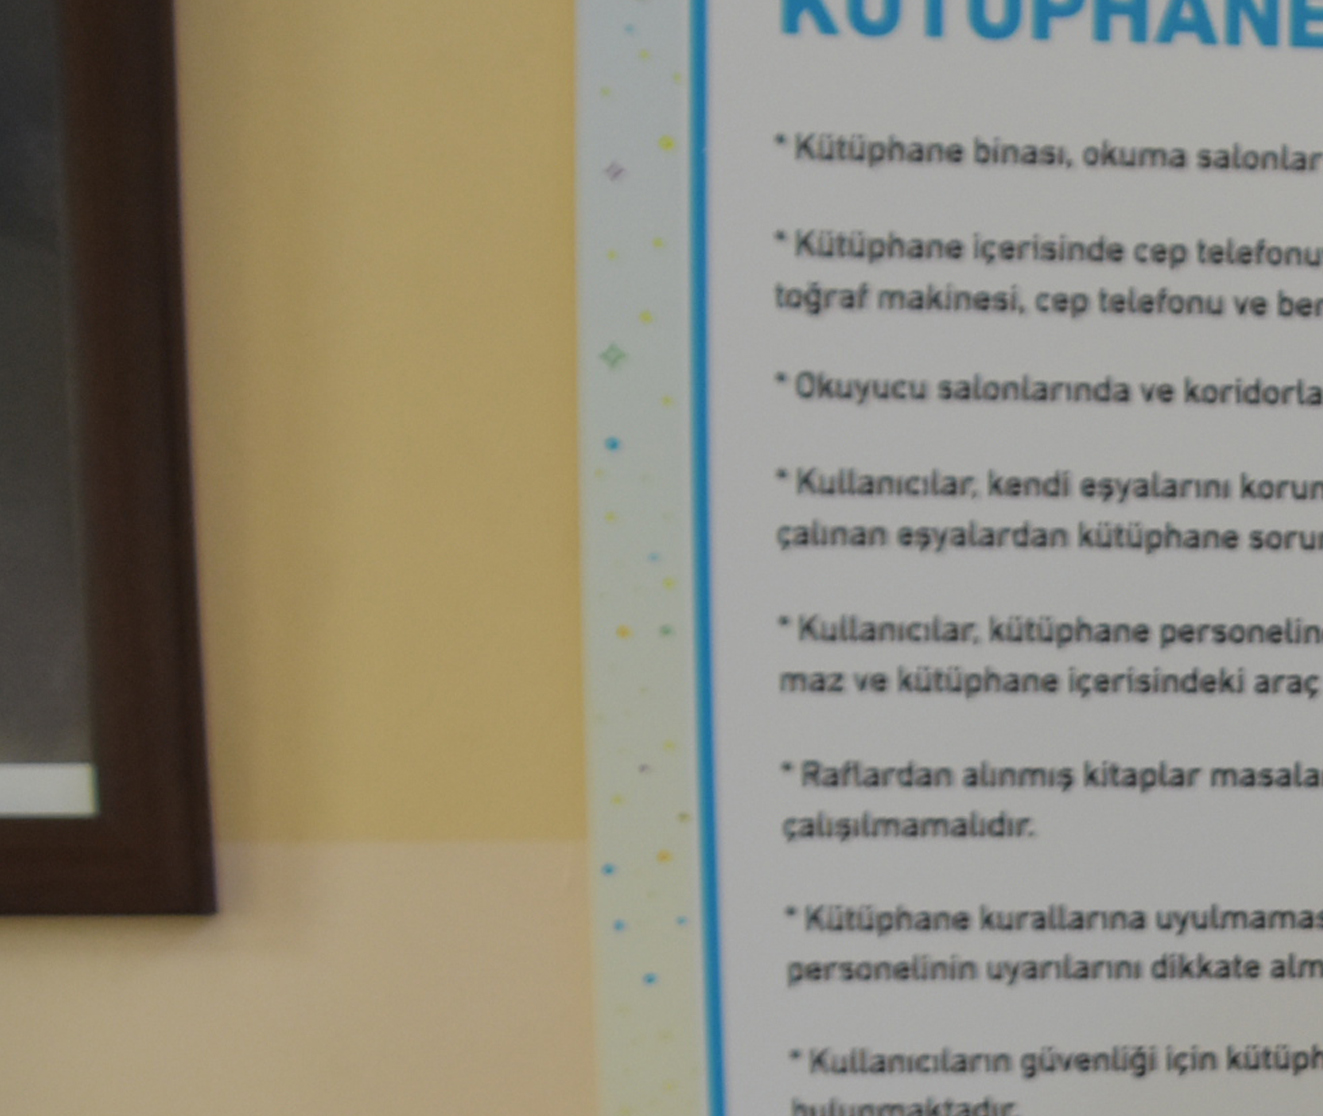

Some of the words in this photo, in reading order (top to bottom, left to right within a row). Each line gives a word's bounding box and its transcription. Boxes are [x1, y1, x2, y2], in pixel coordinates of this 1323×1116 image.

[794, 133, 966, 169] Kütüphane
[973, 136, 1074, 170] binası,
[1082, 139, 1189, 170] okuma
[794, 229, 966, 264] Kütüphane
[973, 232, 1127, 266] içerisinde
[1133, 242, 1190, 270] cep
[774, 281, 870, 317] toğraf
[877, 284, 1026, 315] makinesi,
[1034, 292, 1091, 319] cep
[1097, 287, 1226, 318] telefonu
[1233, 295, 1270, 318] ve
[794, 370, 929, 406] Okuyucu
[937, 373, 1133, 405] salonlarında
[1139, 382, 1177, 405] ve
[796, 467, 978, 499] Kullanıcılar,
[987, 469, 1072, 499] kendi
[1079, 471, 1232, 504] eşyalarını
[776, 520, 889, 551] çalınan
[896, 521, 1070, 554] eşyalardan
[1077, 521, 1241, 556] kütüphane
[797, 614, 980, 645] Kullanıcılar,
[988, 615, 1153, 649] kütüphane
[779, 671, 846, 694] maz
[853, 672, 890, 694] ve
[897, 666, 1061, 700] kütüphane
[1068, 666, 1246, 699] içerisindeki
[1253, 673, 1321, 700] araç
[800, 759, 955, 789] Raflardan
[962, 760, 1076, 793] alınmış
[1083, 760, 1203, 794] kitaplar
[782, 810, 1035, 843] çalışılmamalıdır.
[804, 904, 973, 937] Kütüphane
[979, 904, 1148, 932] kurallarına
[787, 955, 979, 988] personelinin
[985, 953, 1143, 987] uyarılarını
[1150, 953, 1262, 981] dikkate
[809, 1047, 1013, 1076] Kullanıcıların
[1019, 1045, 1158, 1081] güvenliği
[1165, 1044, 1219, 1077] için
